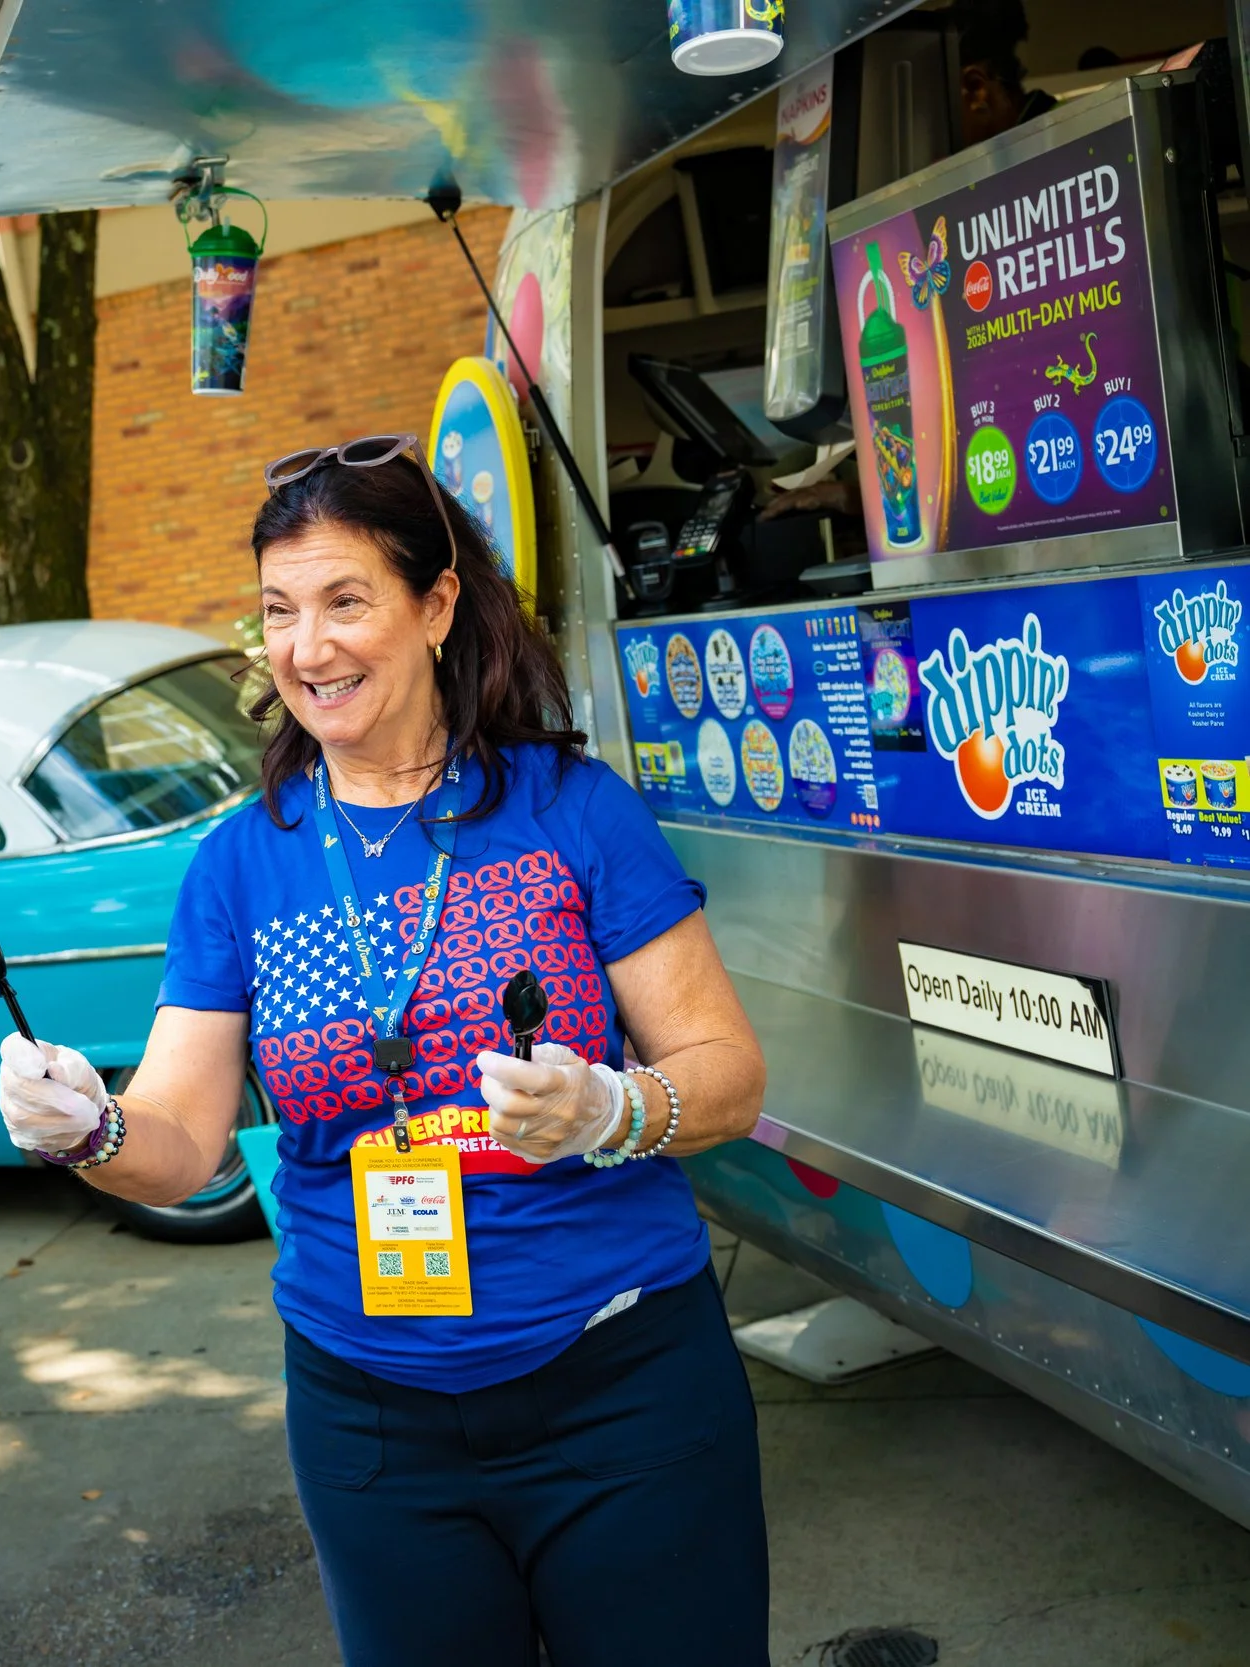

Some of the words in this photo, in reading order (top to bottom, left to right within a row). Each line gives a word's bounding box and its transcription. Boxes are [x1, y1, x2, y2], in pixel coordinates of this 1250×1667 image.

[781, 83, 828, 127] NAPKINS
[957, 164, 1120, 261] UNLIMITED
[996, 215, 1126, 300] REFILLS
[987, 294, 1075, 343] MULTI-DAY
[1079, 280, 1122, 316] MUG
[967, 333, 988, 349] 2026
[1104, 377, 1124, 396] BUY
[1127, 378, 1131, 391] 1
[970, 402, 989, 418] BUY
[989, 401, 995, 414] 3
[1033, 394, 1052, 412] BUY
[1053, 394, 1061, 408] 2
[981, 416, 994, 425] MORE
[1058, 459, 1076, 471] EACH
[996, 469, 1011, 480] EACH
[1203, 637, 1236, 664] dots
[1210, 673, 1236, 681] CREAM
[1206, 711, 1219, 719] Dairy
[1003, 729, 1060, 779] dots
[1025, 788, 1048, 803] ICE
[1016, 801, 1062, 818] CREAM
[1166, 810, 1195, 823] Regular
[1199, 811, 1215, 823] Best
[1216, 813, 1242, 825] Value!
[1172, 822, 1192, 835] $8.49
[1211, 825, 1232, 838] $9.99
[352, 928, 362, 939] IS
[355, 938, 373, 978] Winning
[907, 964, 954, 1003] Open
[956, 974, 1002, 1022] Daily
[1010, 987, 1062, 1029] 10:00
[1070, 1001, 1104, 1041] AM
[396, 1176, 415, 1185] PFG
